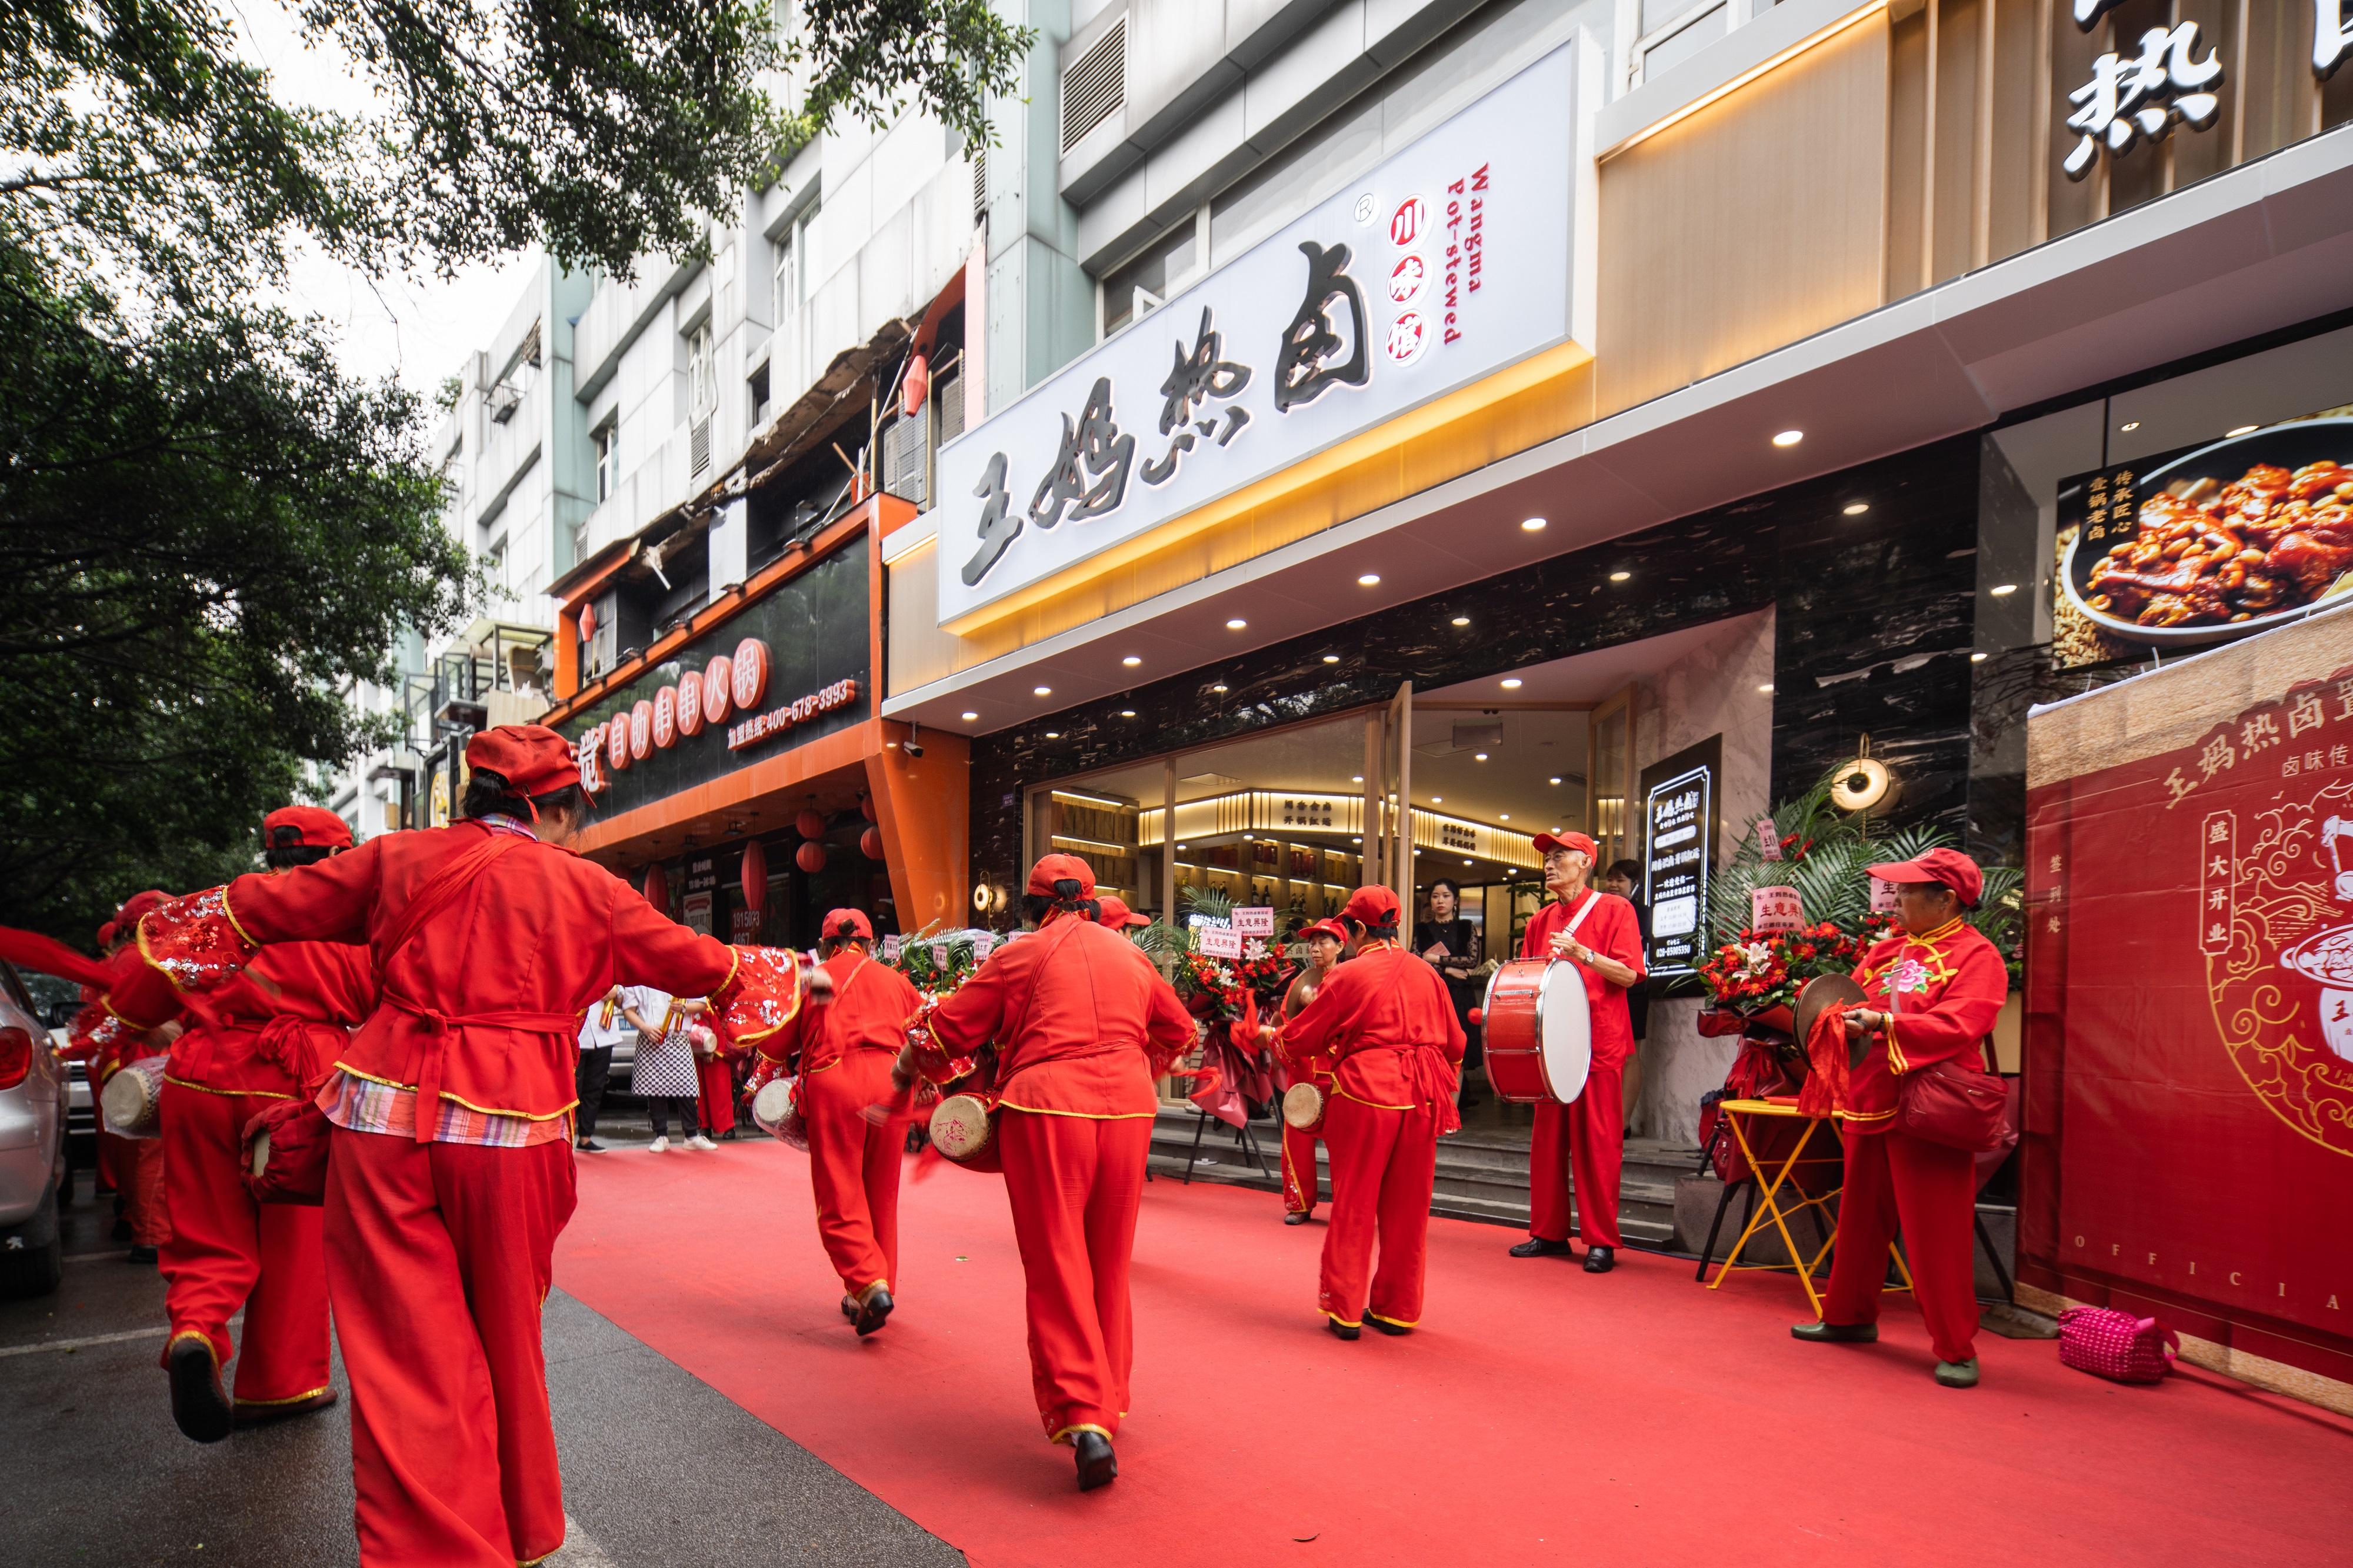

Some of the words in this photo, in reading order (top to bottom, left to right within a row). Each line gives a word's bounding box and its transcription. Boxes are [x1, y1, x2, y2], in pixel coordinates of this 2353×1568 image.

[1388, 196, 1426, 360] 川味馆
[1444, 178, 1464, 345] Pot-stewed
[1465, 162, 1489, 293] Wangma
[961, 240, 1369, 587] 王妈热卤
[2086, 476, 2108, 541] 壹锅老卤
[2112, 469, 2135, 533] 传承匠心
[611, 644, 755, 762] 自助串串火锅
[2047, 855, 2062, 933] 签到处
[2208, 820, 2229, 943] 盛大开业
